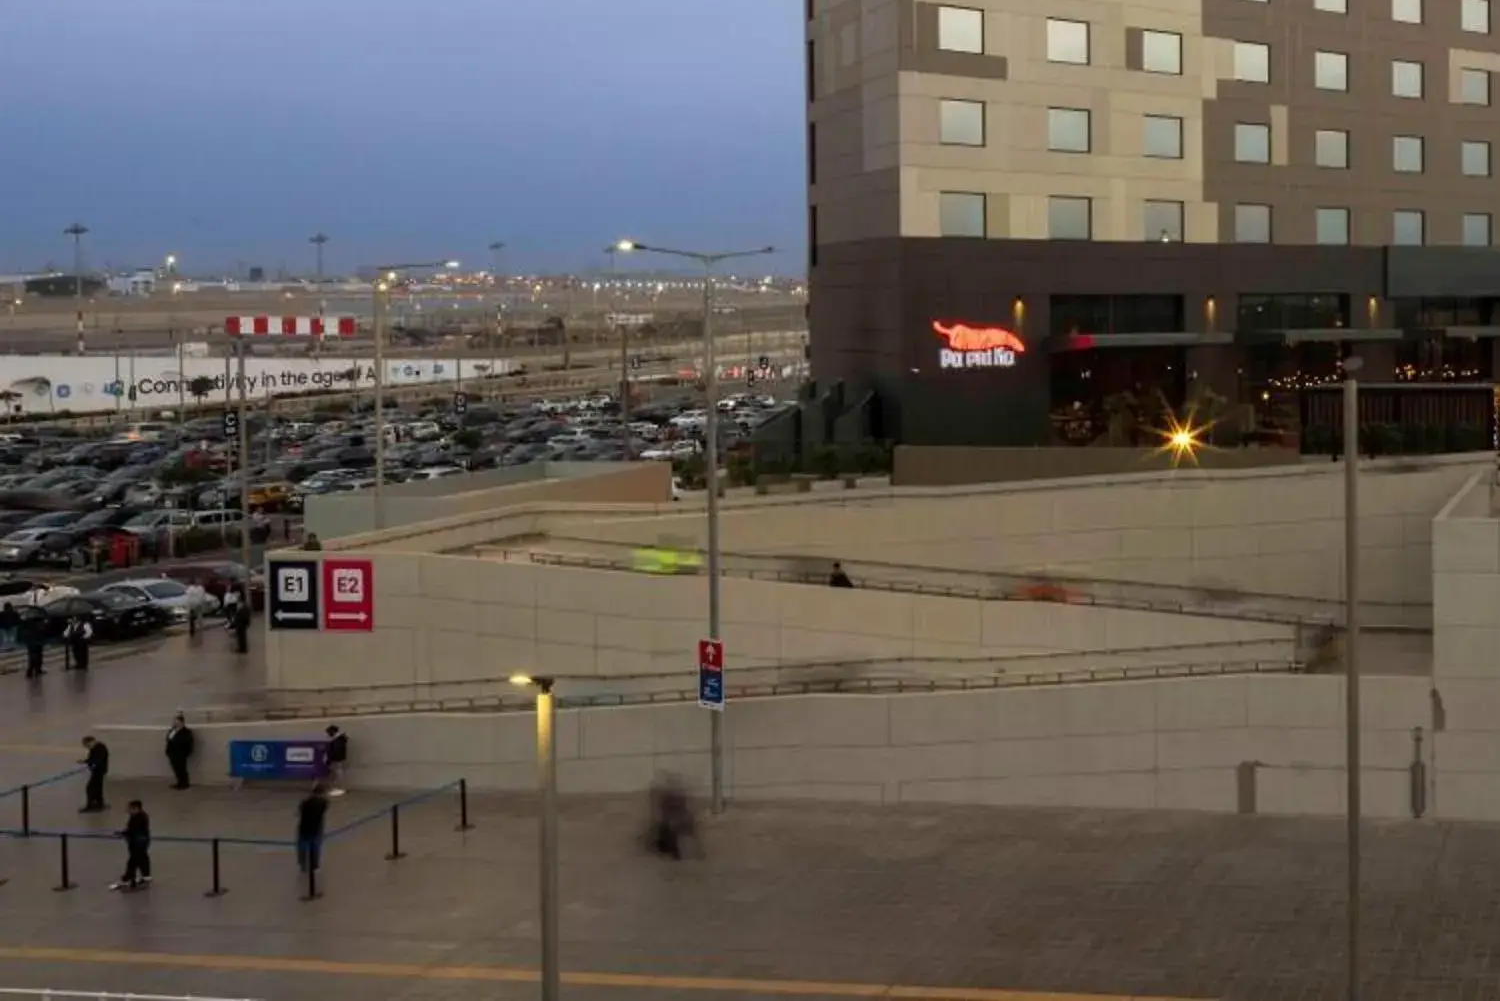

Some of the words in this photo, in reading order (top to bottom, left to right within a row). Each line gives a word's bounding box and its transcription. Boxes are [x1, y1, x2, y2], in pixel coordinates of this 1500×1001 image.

[261, 369, 276, 387] in
[280, 369, 308, 386] the
[284, 576, 304, 593] E1
[337, 576, 360, 594] E2
